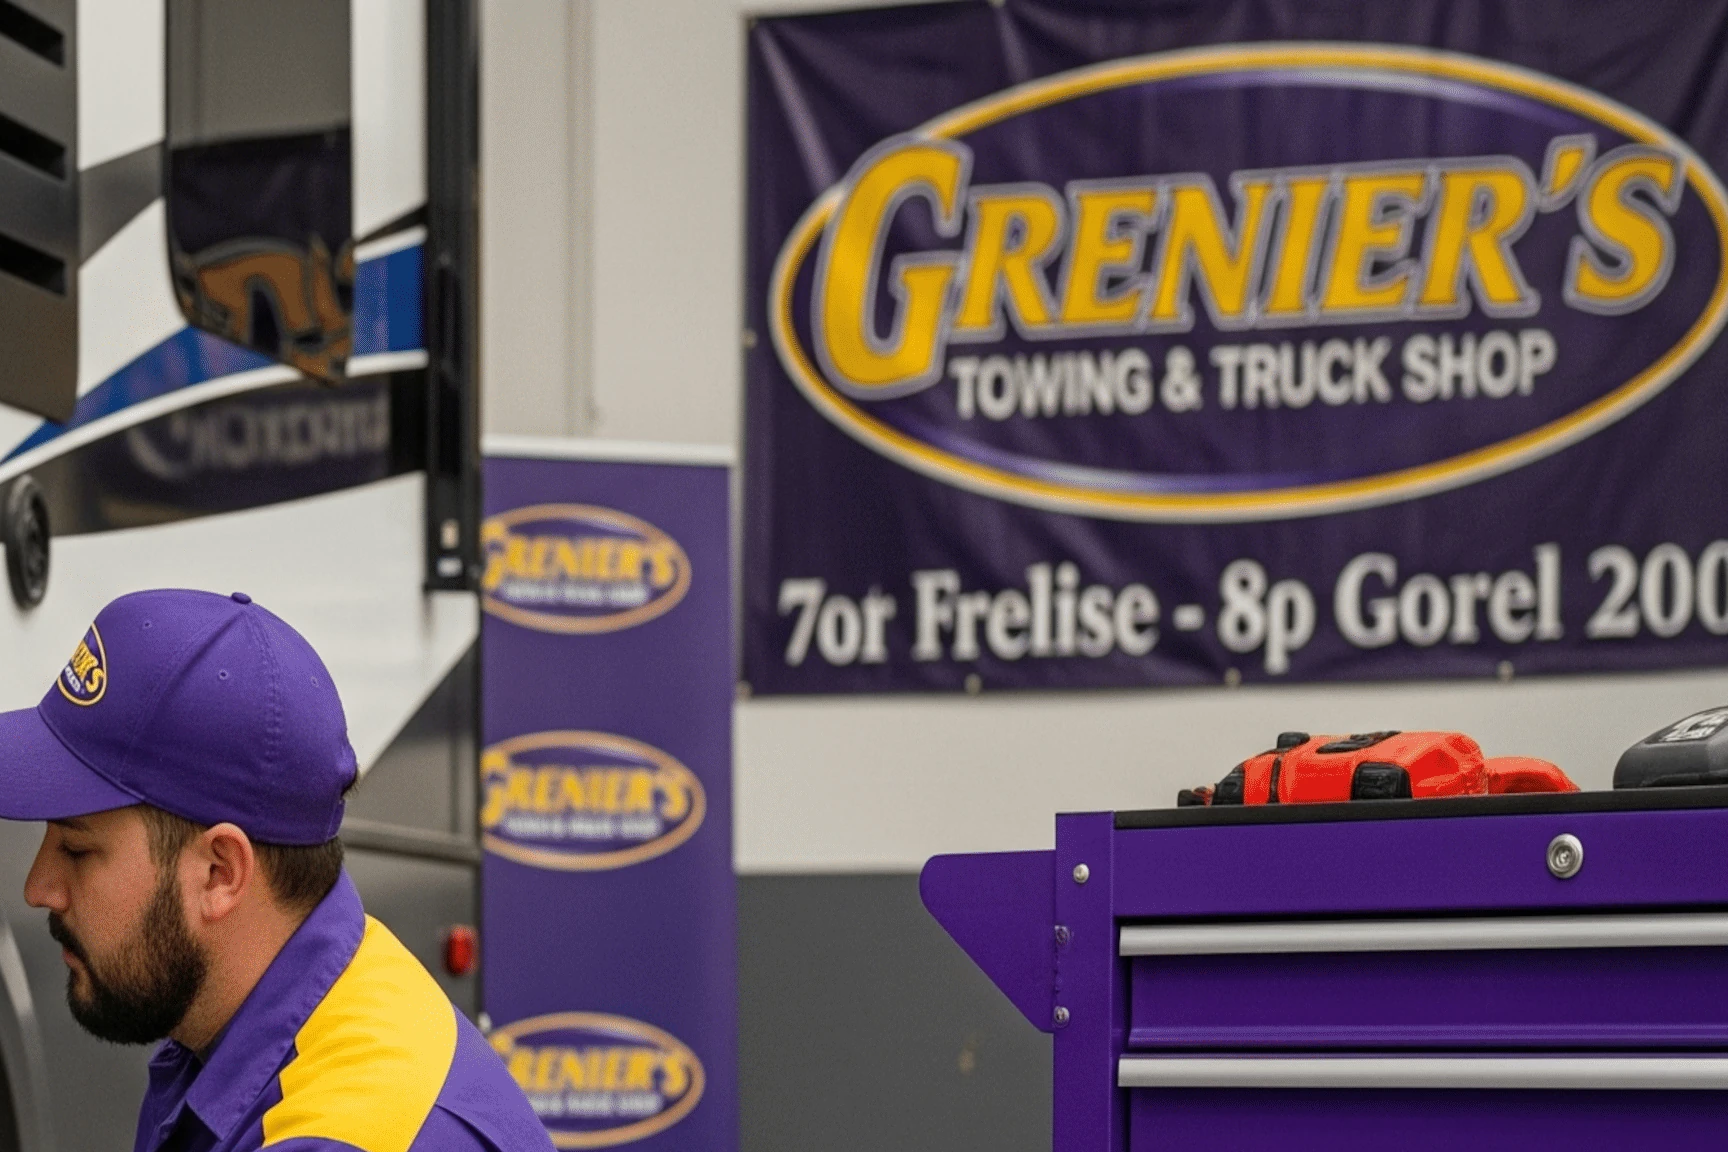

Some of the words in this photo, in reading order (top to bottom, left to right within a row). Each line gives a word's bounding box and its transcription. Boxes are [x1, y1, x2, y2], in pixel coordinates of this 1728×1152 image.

[812, 133, 1686, 398] GRENIER'S
[950, 350, 1152, 420] TOWING
[1161, 347, 1204, 413] &
[1210, 336, 1393, 410] TRUCK
[1402, 328, 1557, 402] SHOP
[911, 560, 1161, 662] Frelise
[1216, 557, 1317, 675] 8p
[1332, 541, 1564, 649] Gorel
